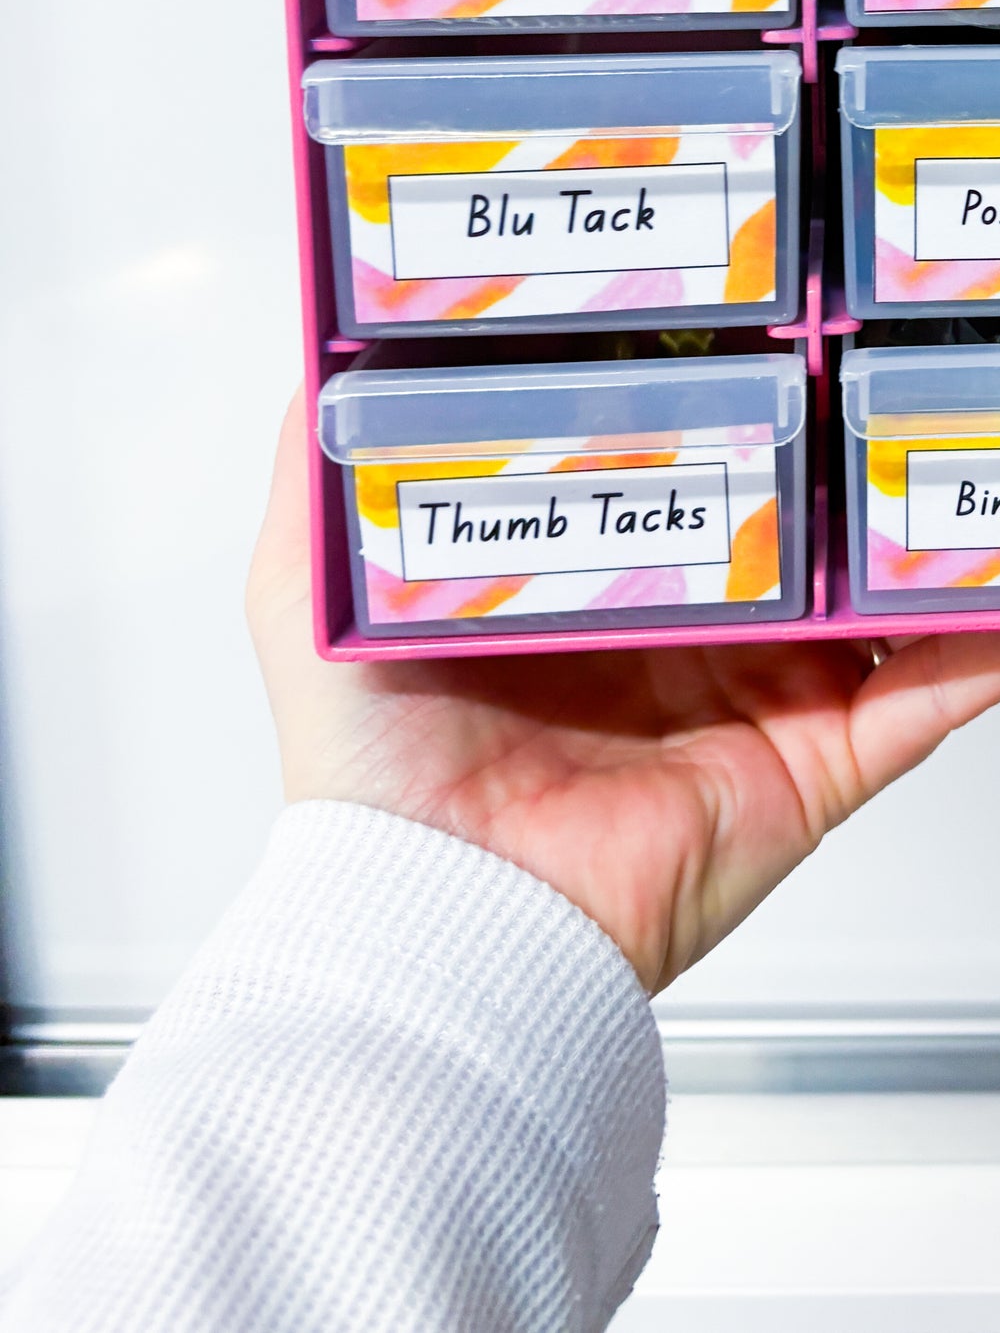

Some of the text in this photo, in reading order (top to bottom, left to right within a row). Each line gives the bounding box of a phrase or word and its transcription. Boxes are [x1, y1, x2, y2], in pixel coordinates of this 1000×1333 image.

[467, 187, 655, 238] Blu Tack
[418, 488, 707, 545] Thumb Tacks
